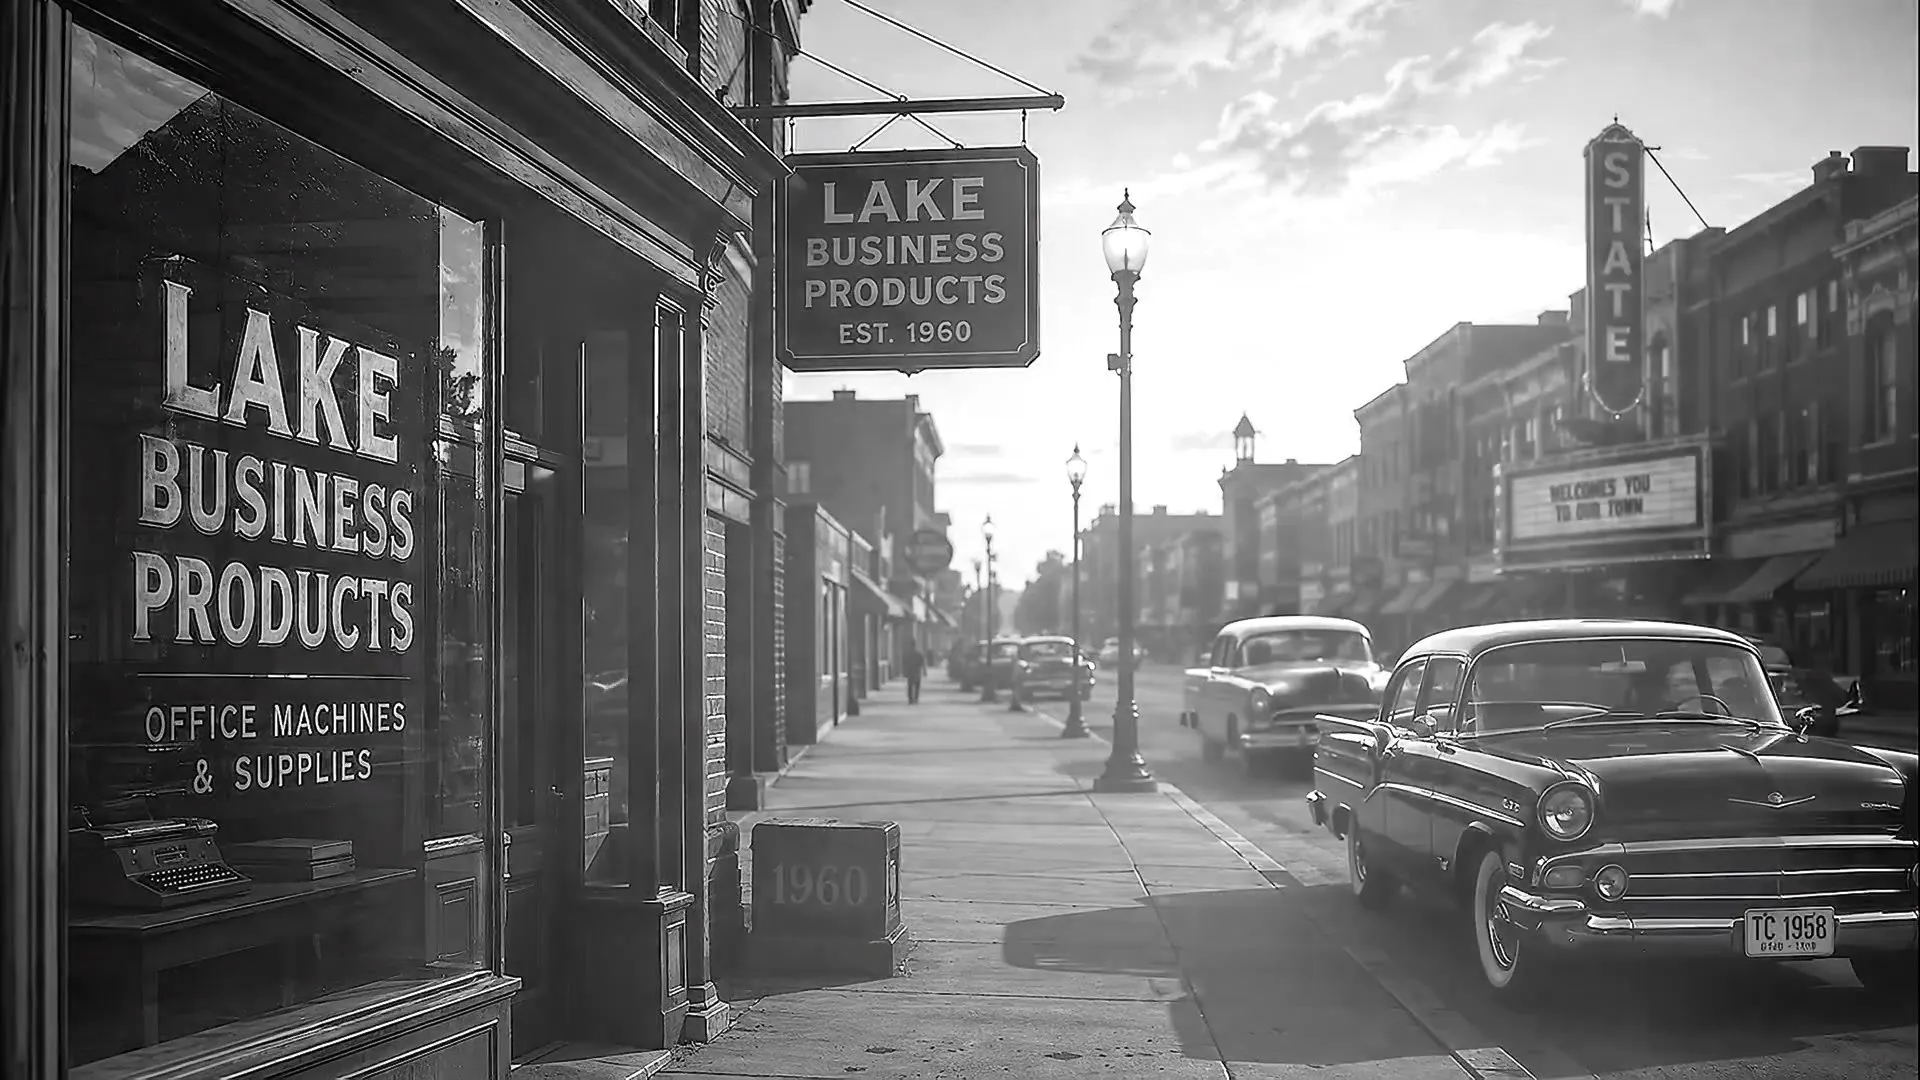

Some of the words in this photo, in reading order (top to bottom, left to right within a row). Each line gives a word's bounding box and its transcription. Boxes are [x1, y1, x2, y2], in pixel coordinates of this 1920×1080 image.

[823, 177, 985, 224] LAKE
[806, 232, 1005, 267] BUSINESS
[1603, 152, 1632, 361] STATE
[804, 274, 1006, 308] PRODUCTS
[839, 323, 894, 344] EST.
[906, 321, 971, 343] 1960
[162, 279, 400, 464] LAKE
[138, 433, 415, 561] BUSINESS
[1623, 473, 1650, 495] YOU
[1608, 497, 1644, 517] TOWN
[131, 551, 415, 653] PRODUCTS
[145, 704, 257, 742] OFFICE
[273, 702, 406, 737] MACHINES
[193, 758, 213, 794] &
[234, 749, 372, 790] SUPPLIES
[772, 862, 869, 906] 1960
[1751, 915, 1776, 940] TC
[1783, 914, 1827, 940] 1958
